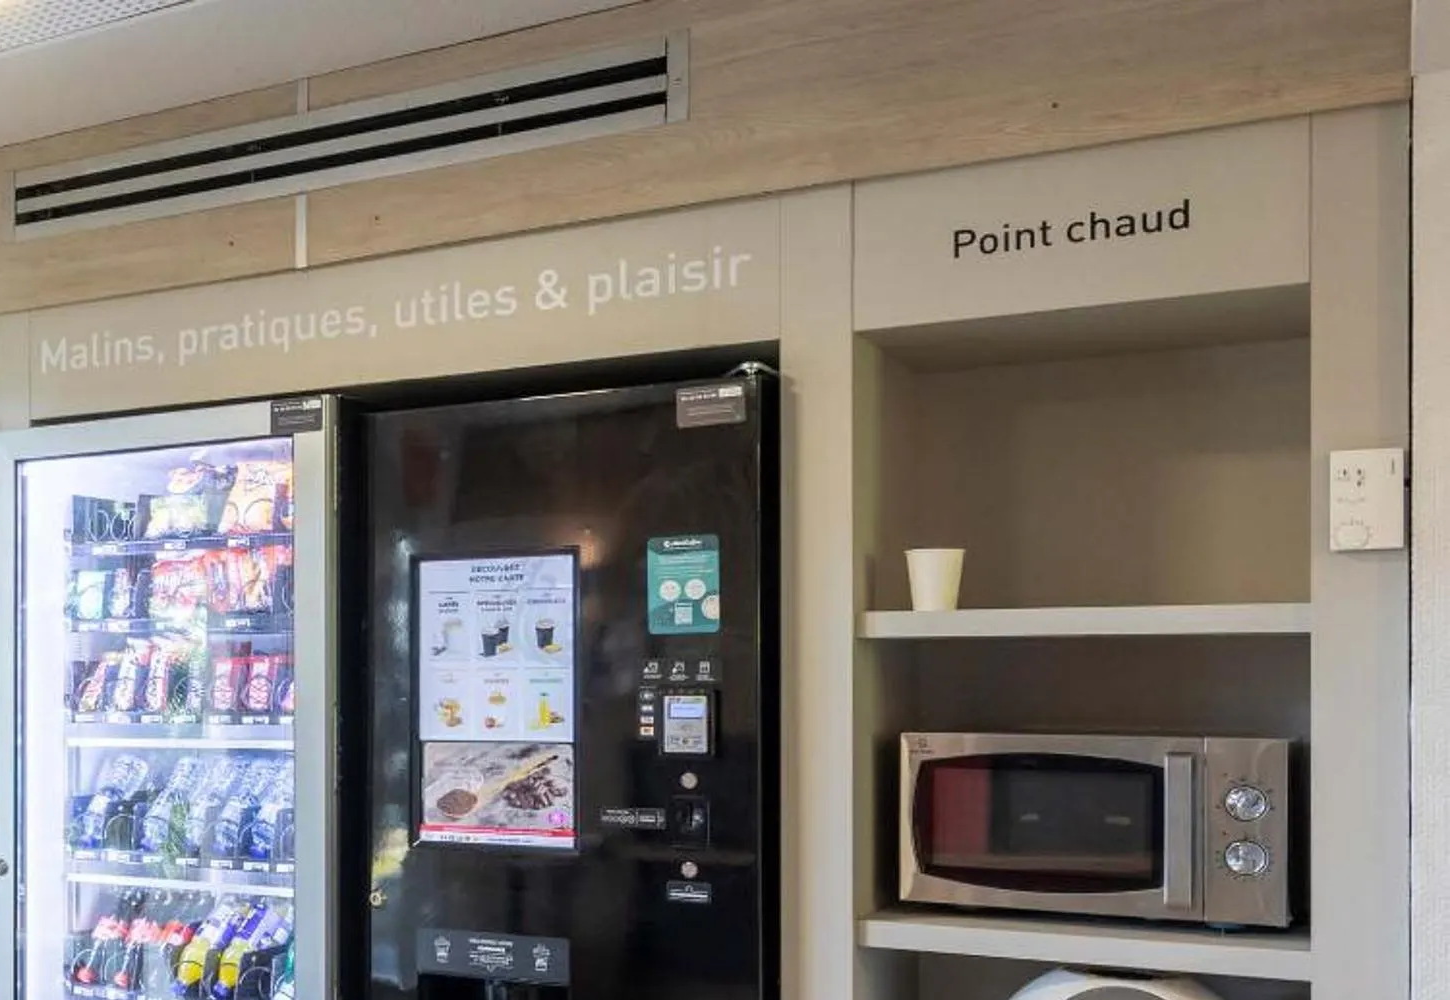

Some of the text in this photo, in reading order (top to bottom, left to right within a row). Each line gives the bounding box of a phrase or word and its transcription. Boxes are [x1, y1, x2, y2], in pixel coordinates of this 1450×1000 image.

[953, 198, 1190, 258] Point chaud
[40, 244, 752, 374] Malins, pratiques, utiles & plaisir
